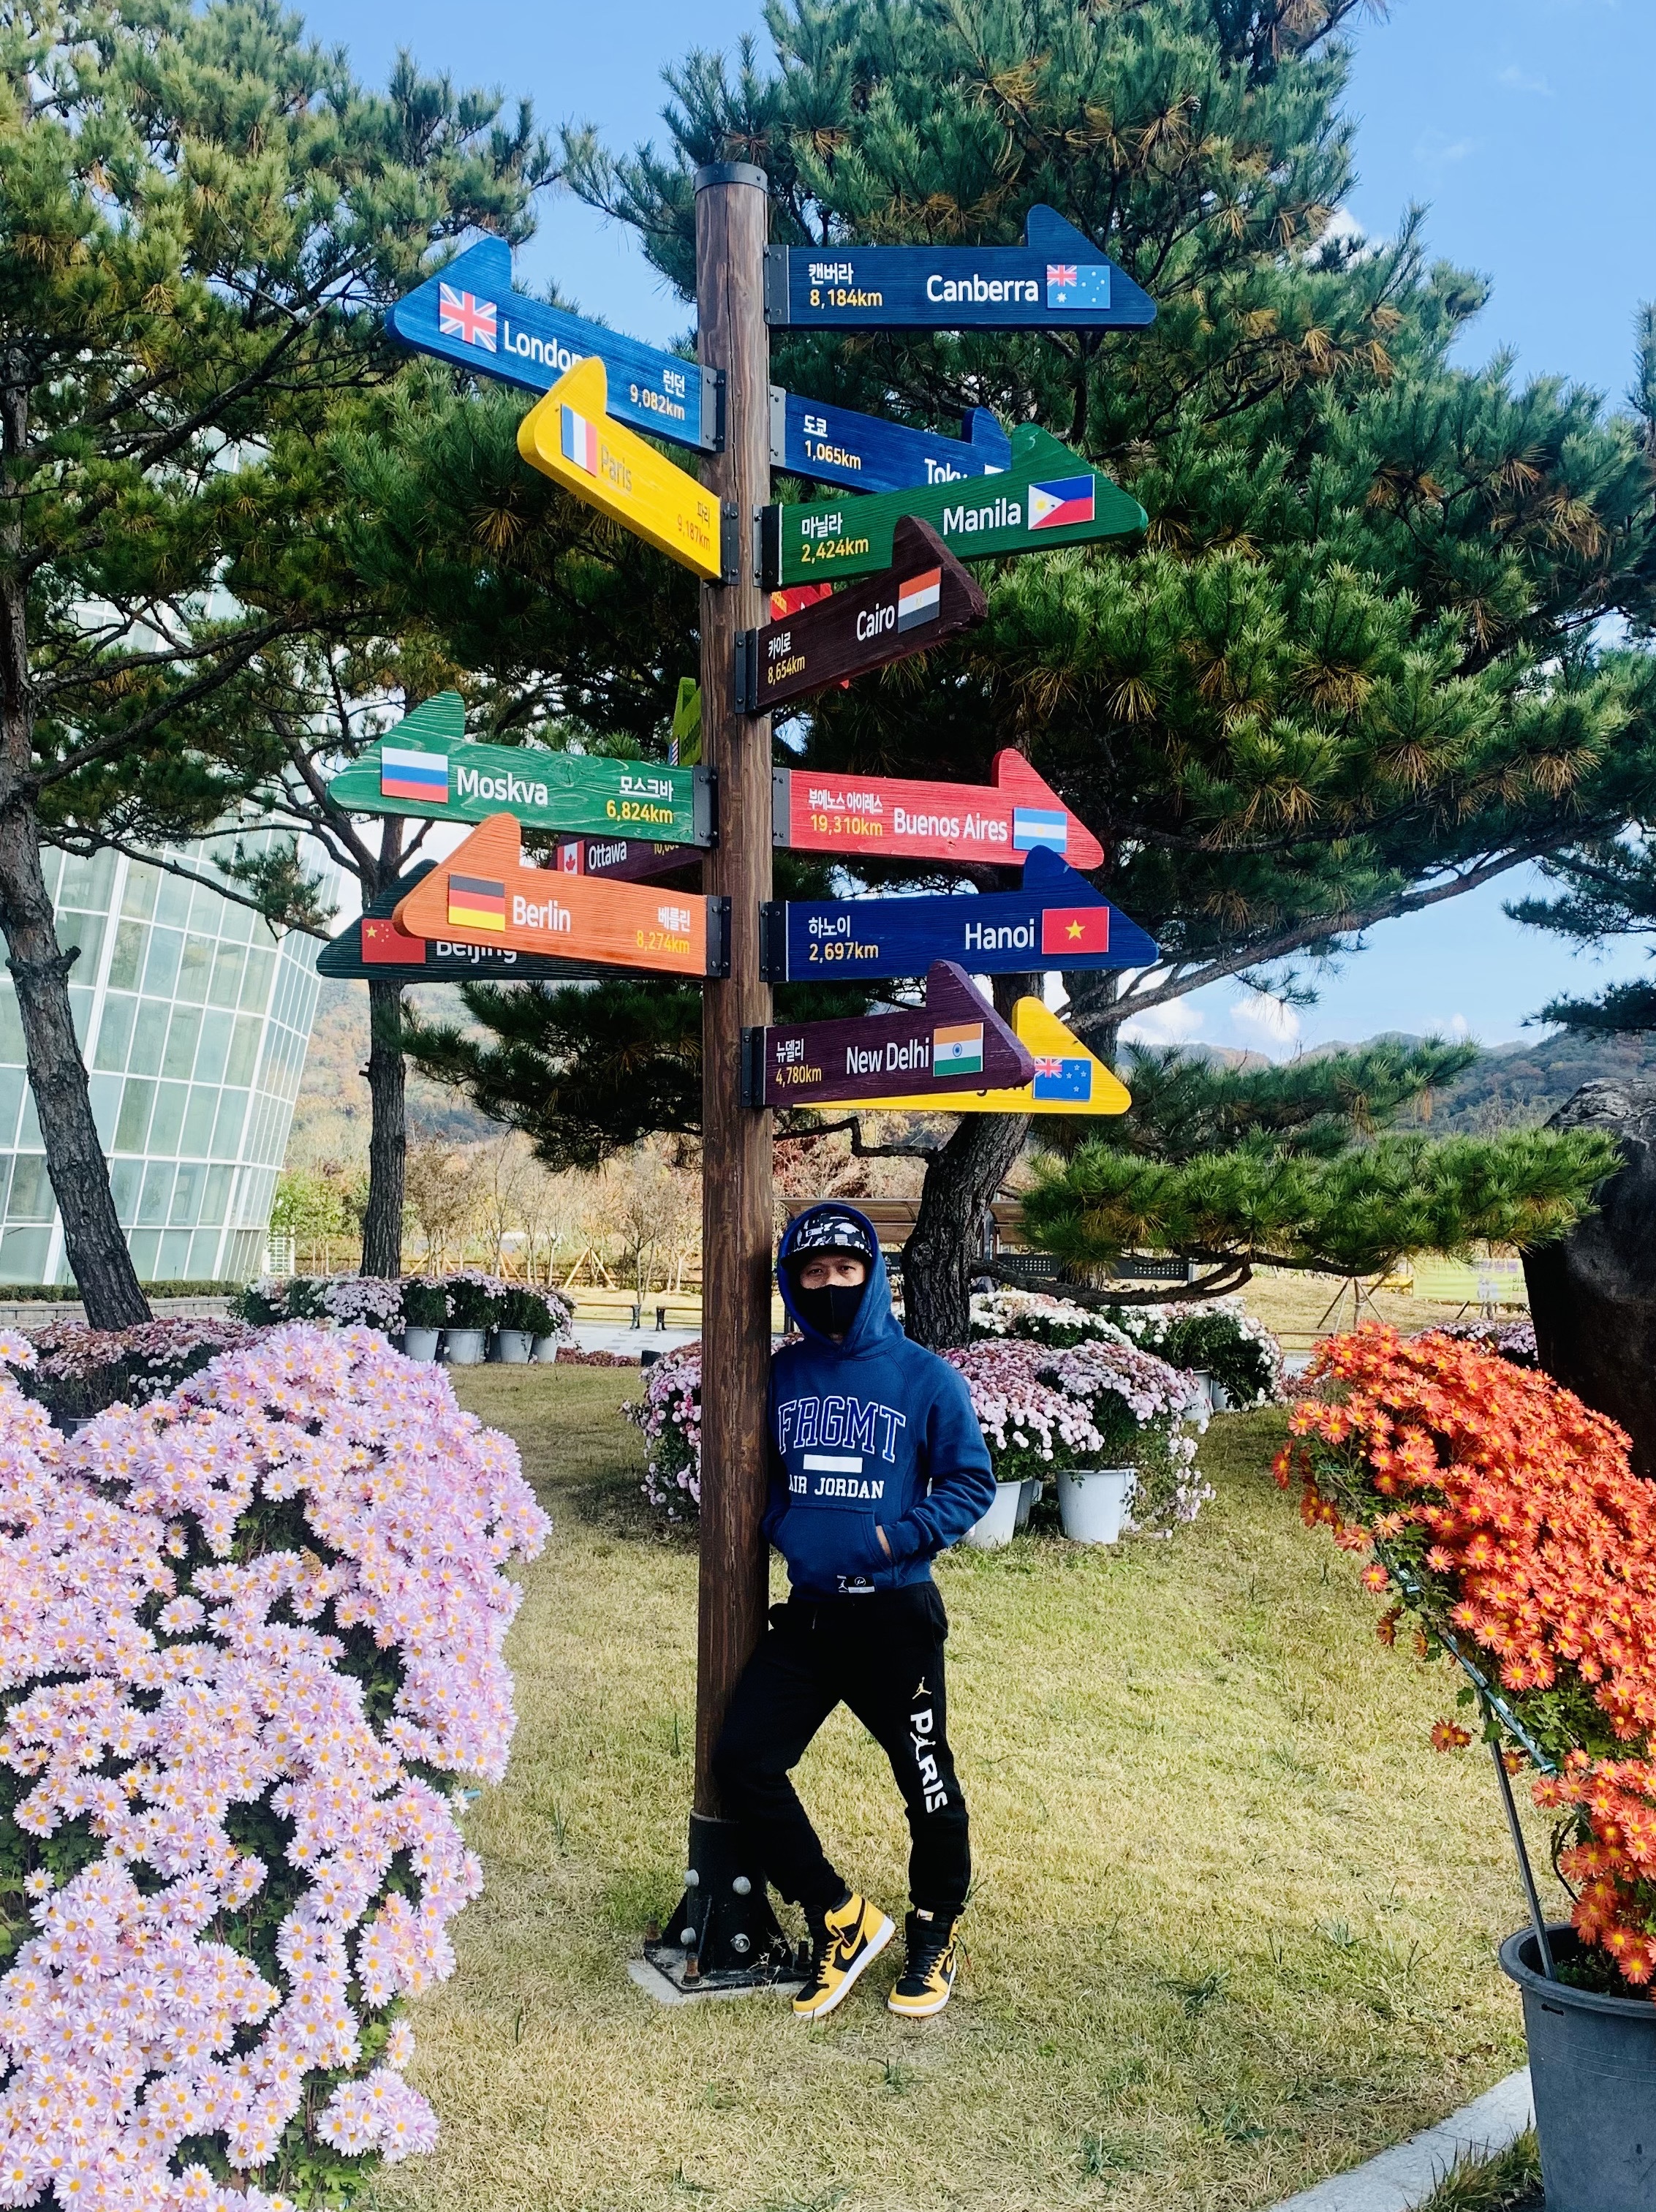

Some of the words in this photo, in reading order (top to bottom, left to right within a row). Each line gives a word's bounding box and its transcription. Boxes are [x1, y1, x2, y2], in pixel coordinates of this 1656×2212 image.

[809, 263, 854, 284] 캔버라
[810, 288, 882, 309] 8,184km
[926, 274, 1038, 302] Canberra
[663, 369, 685, 399] 런던
[804, 415, 828, 437] 도쿄
[601, 444, 632, 491] Paris
[805, 440, 861, 470] 1,065km
[802, 512, 843, 538] 마닐라
[943, 497, 1021, 535] Manila
[678, 513, 711, 551] 9,187km
[801, 537, 869, 564] 2,424km
[856, 603, 895, 641] Cairo
[768, 631, 791, 660] 카이로
[768, 655, 805, 685] 8,654km
[456, 768, 548, 806] Moskva
[619, 775, 673, 802] 모스크바
[606, 799, 673, 823] 6,824km
[893, 807, 960, 838] Buenos
[963, 812, 1008, 841] Aires
[810, 814, 883, 837] 19,310km
[589, 841, 627, 869] Ottawa
[513, 896, 571, 932] Berlin
[658, 906, 690, 932] 베를린
[808, 915, 850, 938] 하노이
[637, 930, 690, 954] 8,274km
[965, 918, 1035, 950] Hanoi
[809, 941, 879, 964] 2,697km
[776, 1038, 804, 1062] 뉴델리
[847, 1046, 882, 1074] New
[886, 1037, 929, 1071] Delhi
[776, 1065, 822, 1087] 4,780km
[779, 1396, 906, 1463] FRGMT
[814, 1477, 884, 1499] JORDAN
